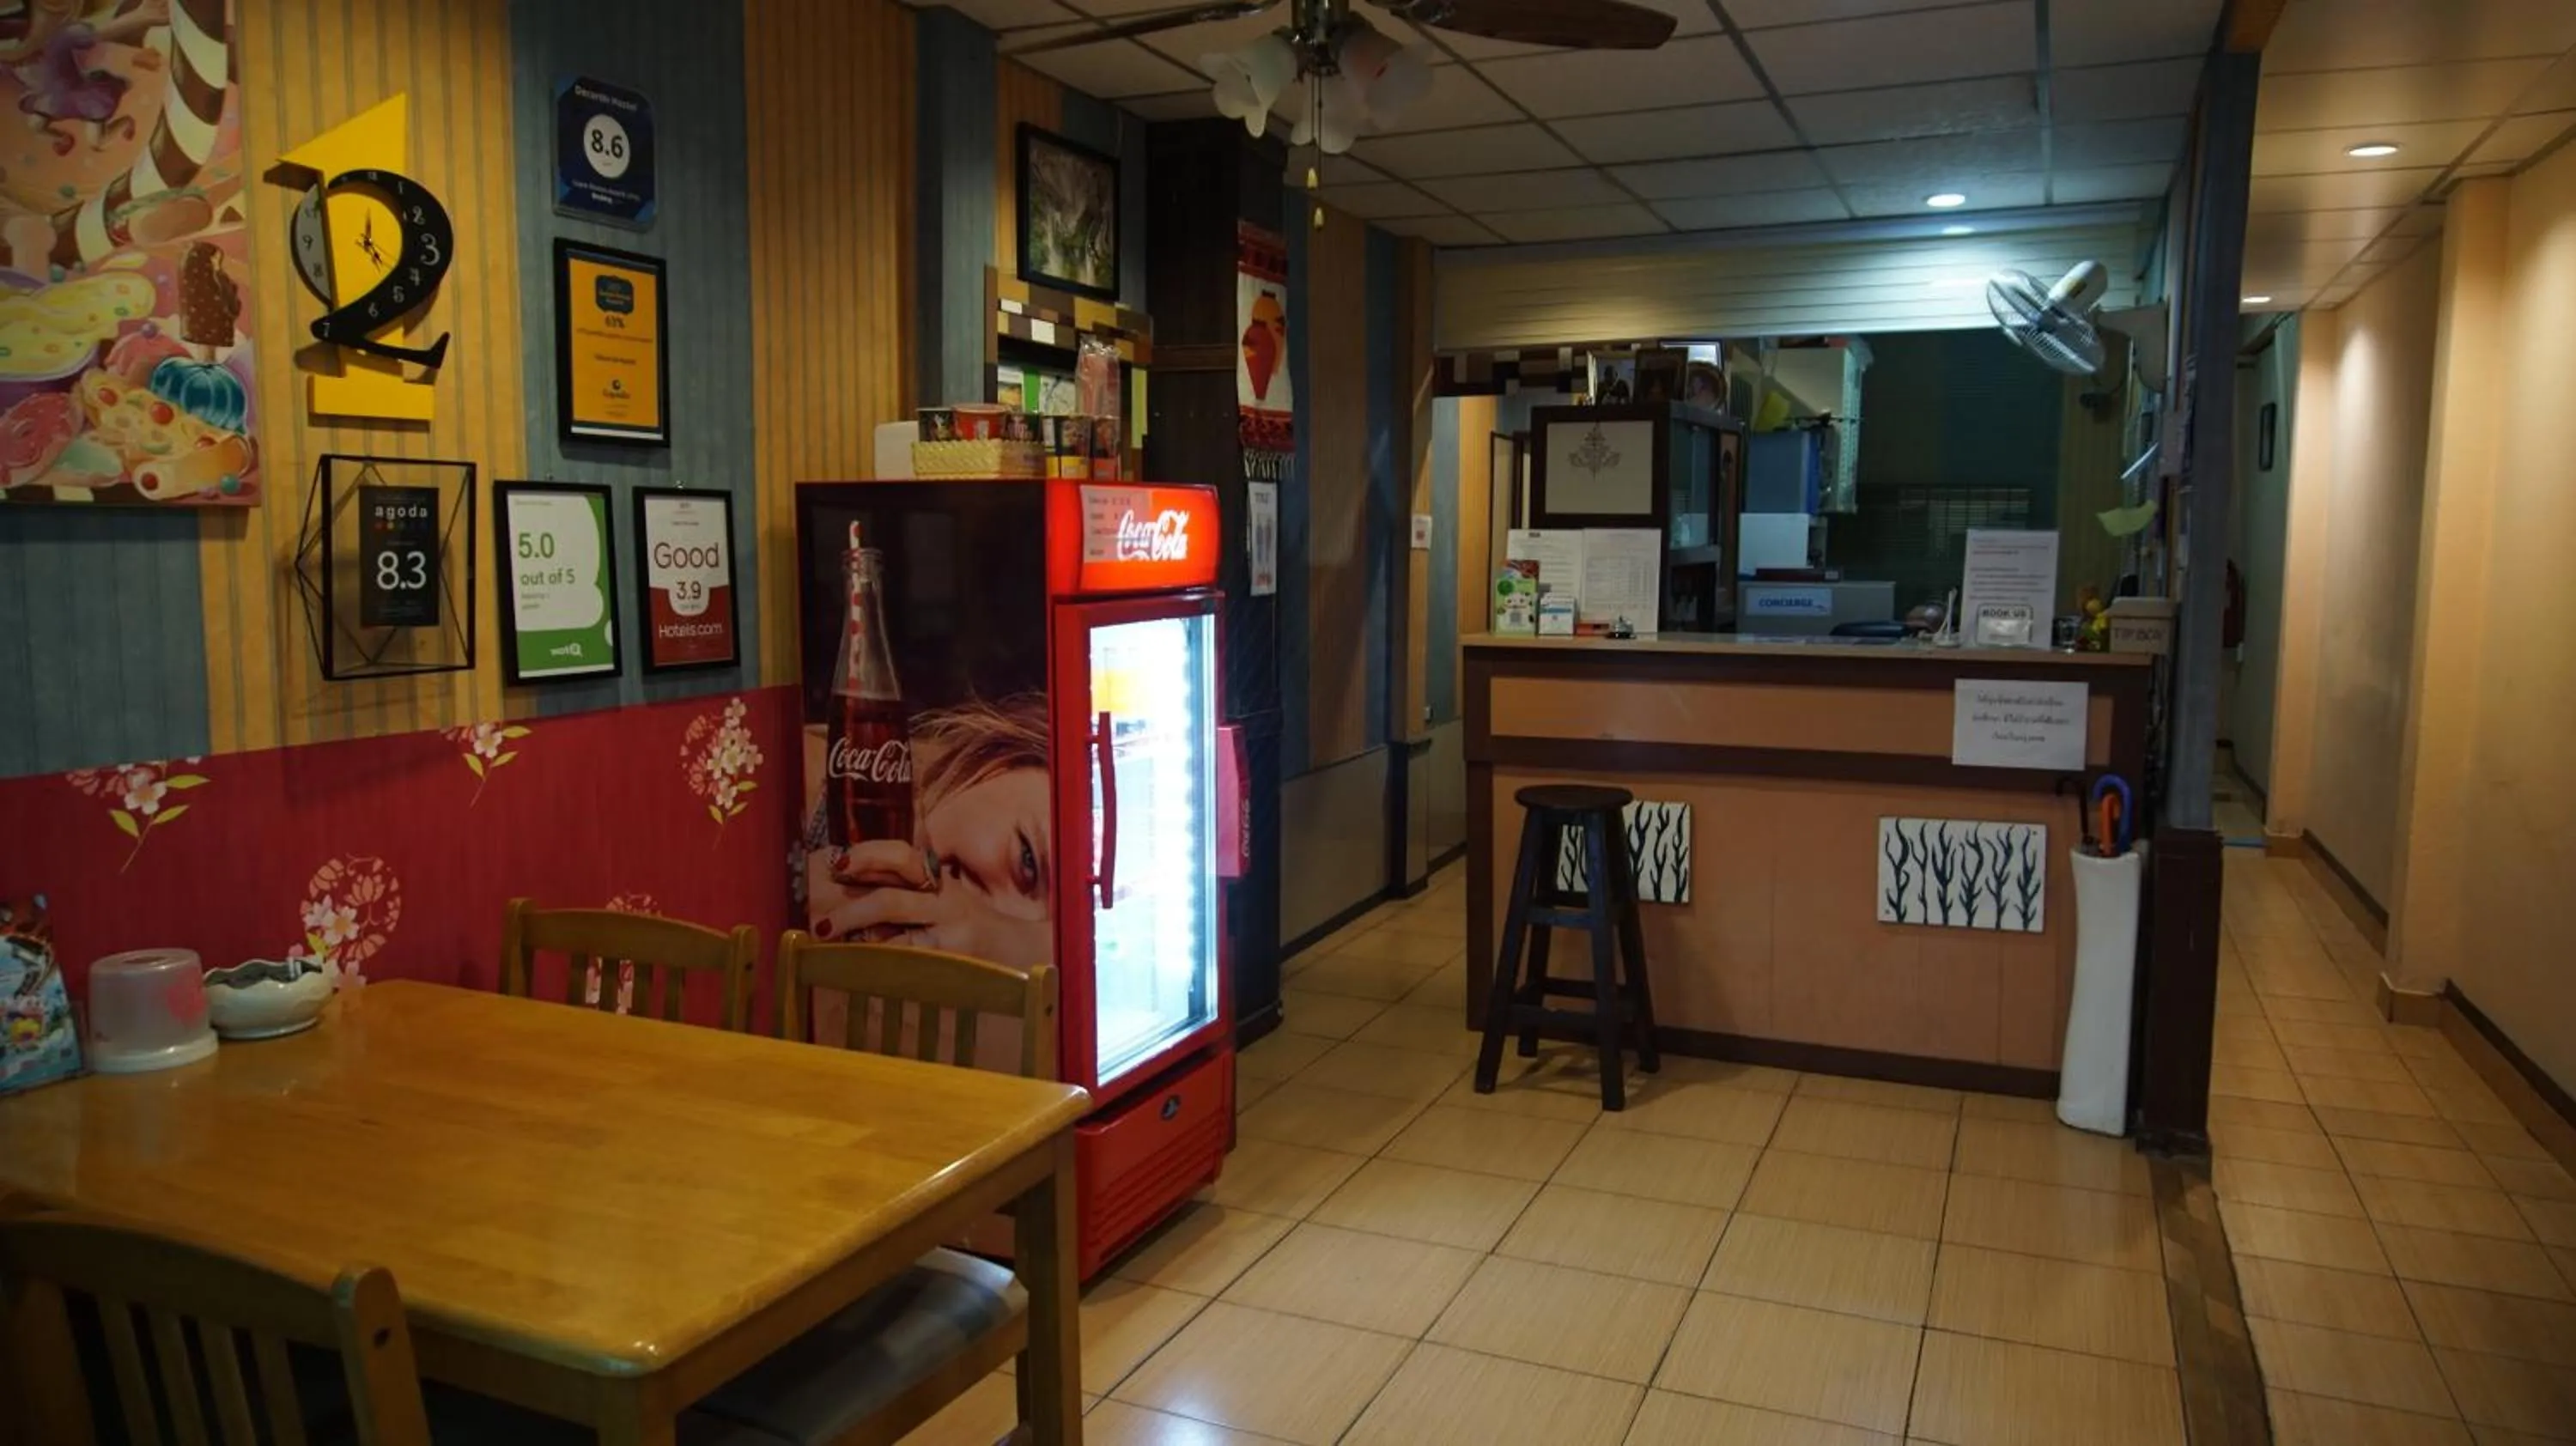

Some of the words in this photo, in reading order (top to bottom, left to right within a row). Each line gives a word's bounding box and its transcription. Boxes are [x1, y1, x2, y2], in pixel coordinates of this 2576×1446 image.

[592, 130, 623, 159] 8.6
[412, 206, 425, 225] 2
[303, 235, 313, 250] 9
[420, 233, 440, 266] 3
[410, 268, 421, 286] 4
[392, 286, 405, 303] 5
[368, 302, 379, 318] 6
[323, 323, 330, 337] 7
[374, 503, 428, 519] agoda
[519, 533, 555, 558] 5.0
[654, 542, 720, 569] Good
[376, 550, 427, 590] 8.3
[520, 572, 544, 586] out
[549, 569, 563, 585] of
[568, 569, 575, 584] 5
[677, 581, 702, 599] 3.9
[659, 623, 723, 639] Hotels.com
[829, 737, 912, 783] Coca-Cola
